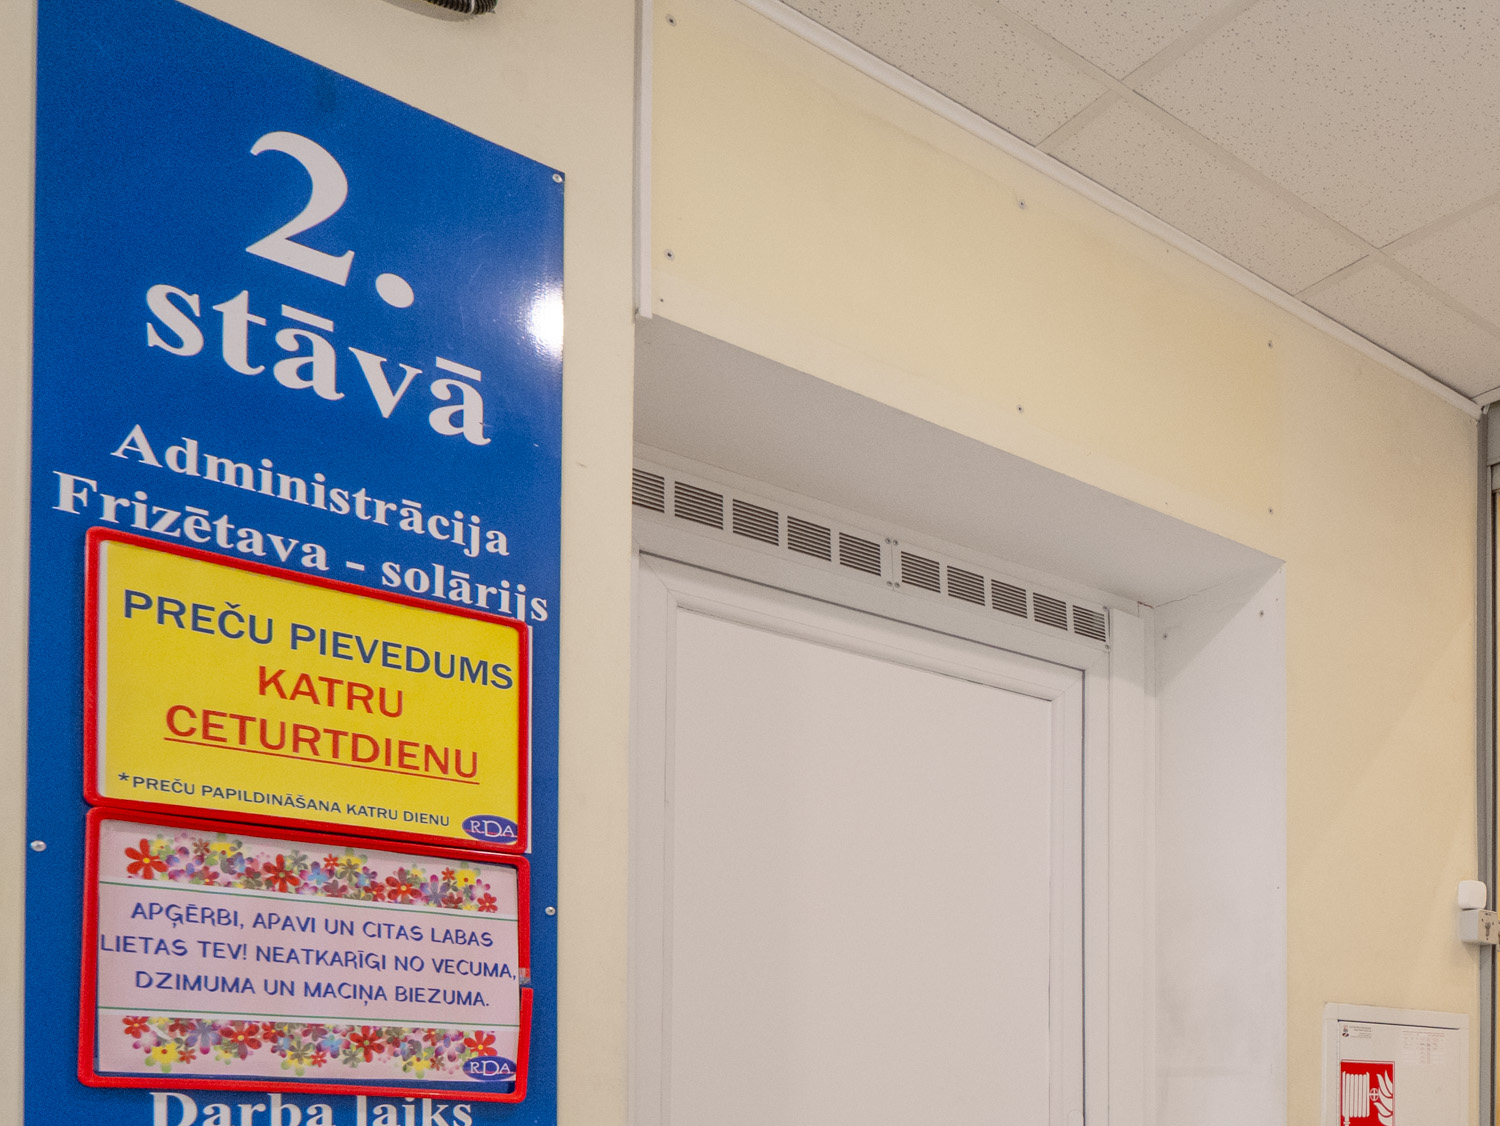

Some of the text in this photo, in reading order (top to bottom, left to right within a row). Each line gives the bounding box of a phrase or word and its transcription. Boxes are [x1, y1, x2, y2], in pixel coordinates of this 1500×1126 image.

[245, 131, 415, 308] 2.
[146, 284, 491, 446] stāvā
[110, 423, 510, 557] Administrācija
[52, 470, 330, 572] Frizētava
[381, 560, 548, 622] solārijs
[124, 589, 514, 690] PREČU PIEVEDUMS
[258, 665, 404, 718] KATRU
[166, 704, 480, 780] CETURTDIENU
[201, 784, 341, 813] PAPILDINĀŠANA
[347, 803, 398, 821] KATRU
[403, 810, 450, 827] DIENU
[470, 819, 517, 838] RDA
[131, 902, 493, 947] APĢĒRBI, APAVI UN CITAS LABAS
[100, 934, 516, 981] LIETAS TEV! NEATKARĪGI NO VECUMA,
[135, 971, 256, 994] DZIMUMA
[263, 978, 295, 997] UN
[395, 986, 489, 1006] BIEZUMA.
[470, 1060, 512, 1077] RDA
